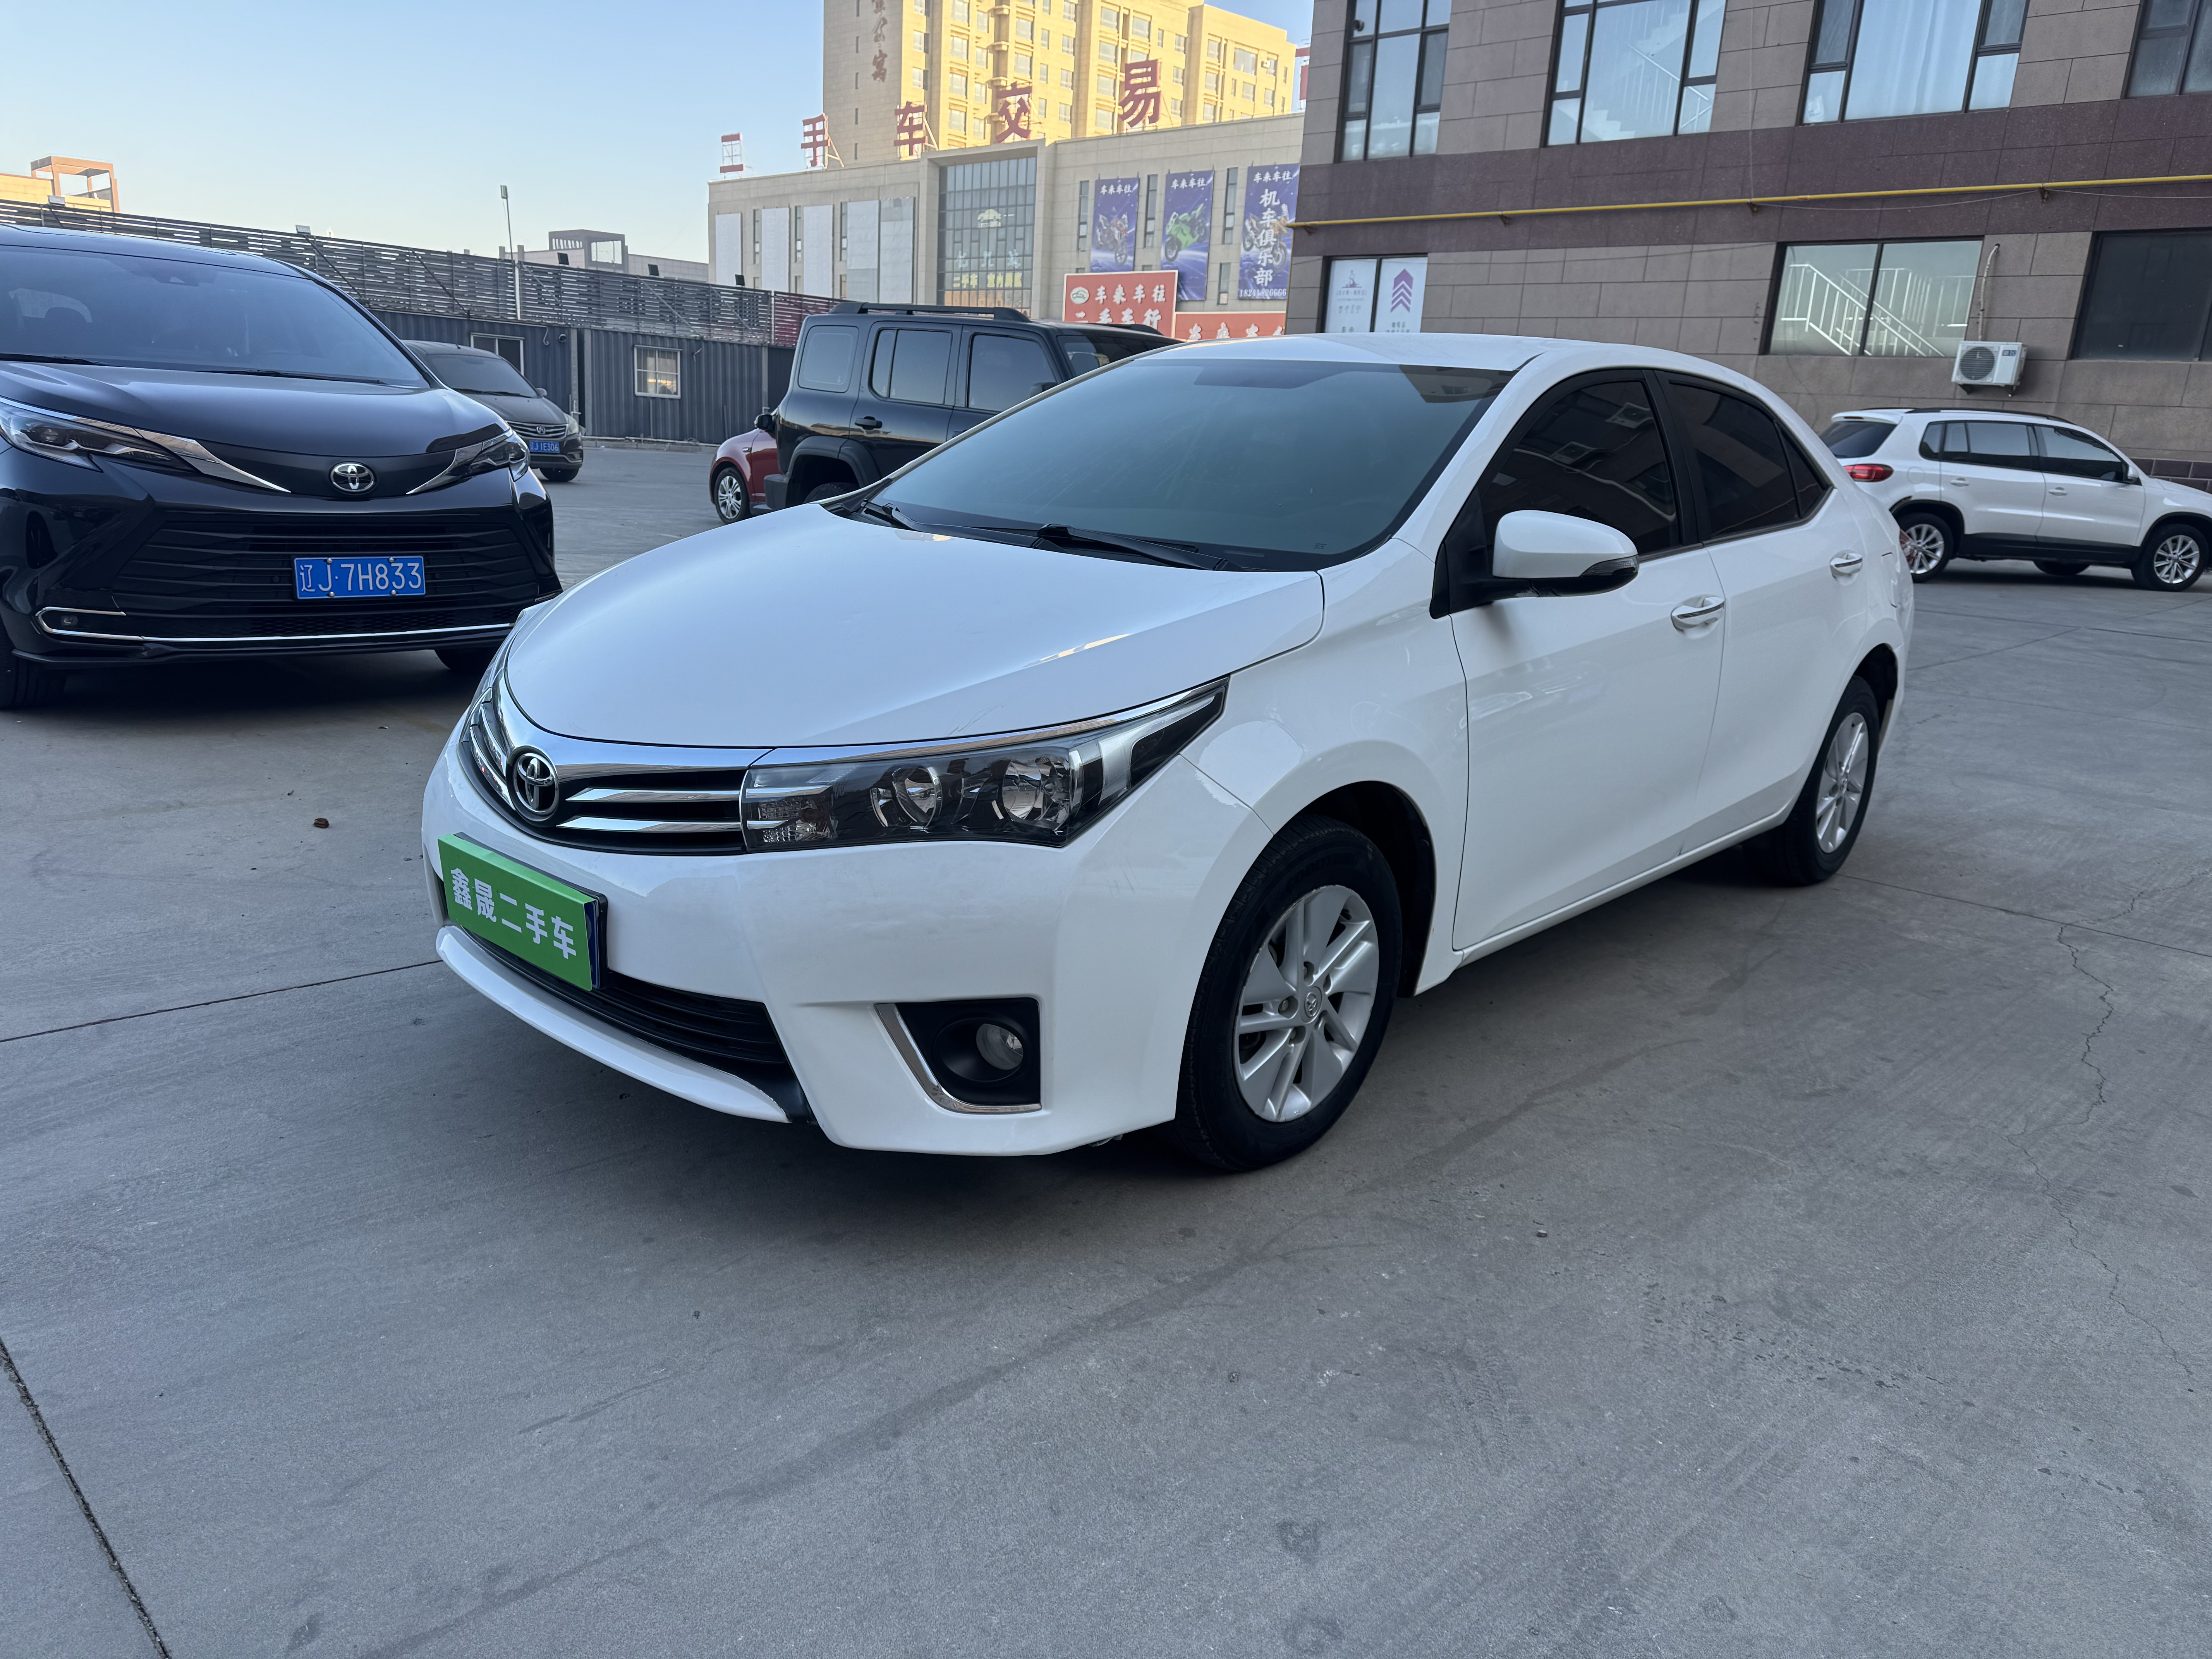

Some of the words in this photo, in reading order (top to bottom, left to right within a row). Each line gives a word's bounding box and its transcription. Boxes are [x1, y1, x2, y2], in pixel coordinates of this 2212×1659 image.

[1171, 177, 1206, 189] 车来车往
[1254, 170, 1292, 183] 车来车往
[1100, 184, 1132, 194] 车来车往
[1254, 189, 1279, 287] 机车俱乐部
[1095, 284, 1166, 305] 车来车往
[451, 868, 577, 960] 鑫晟二手车
